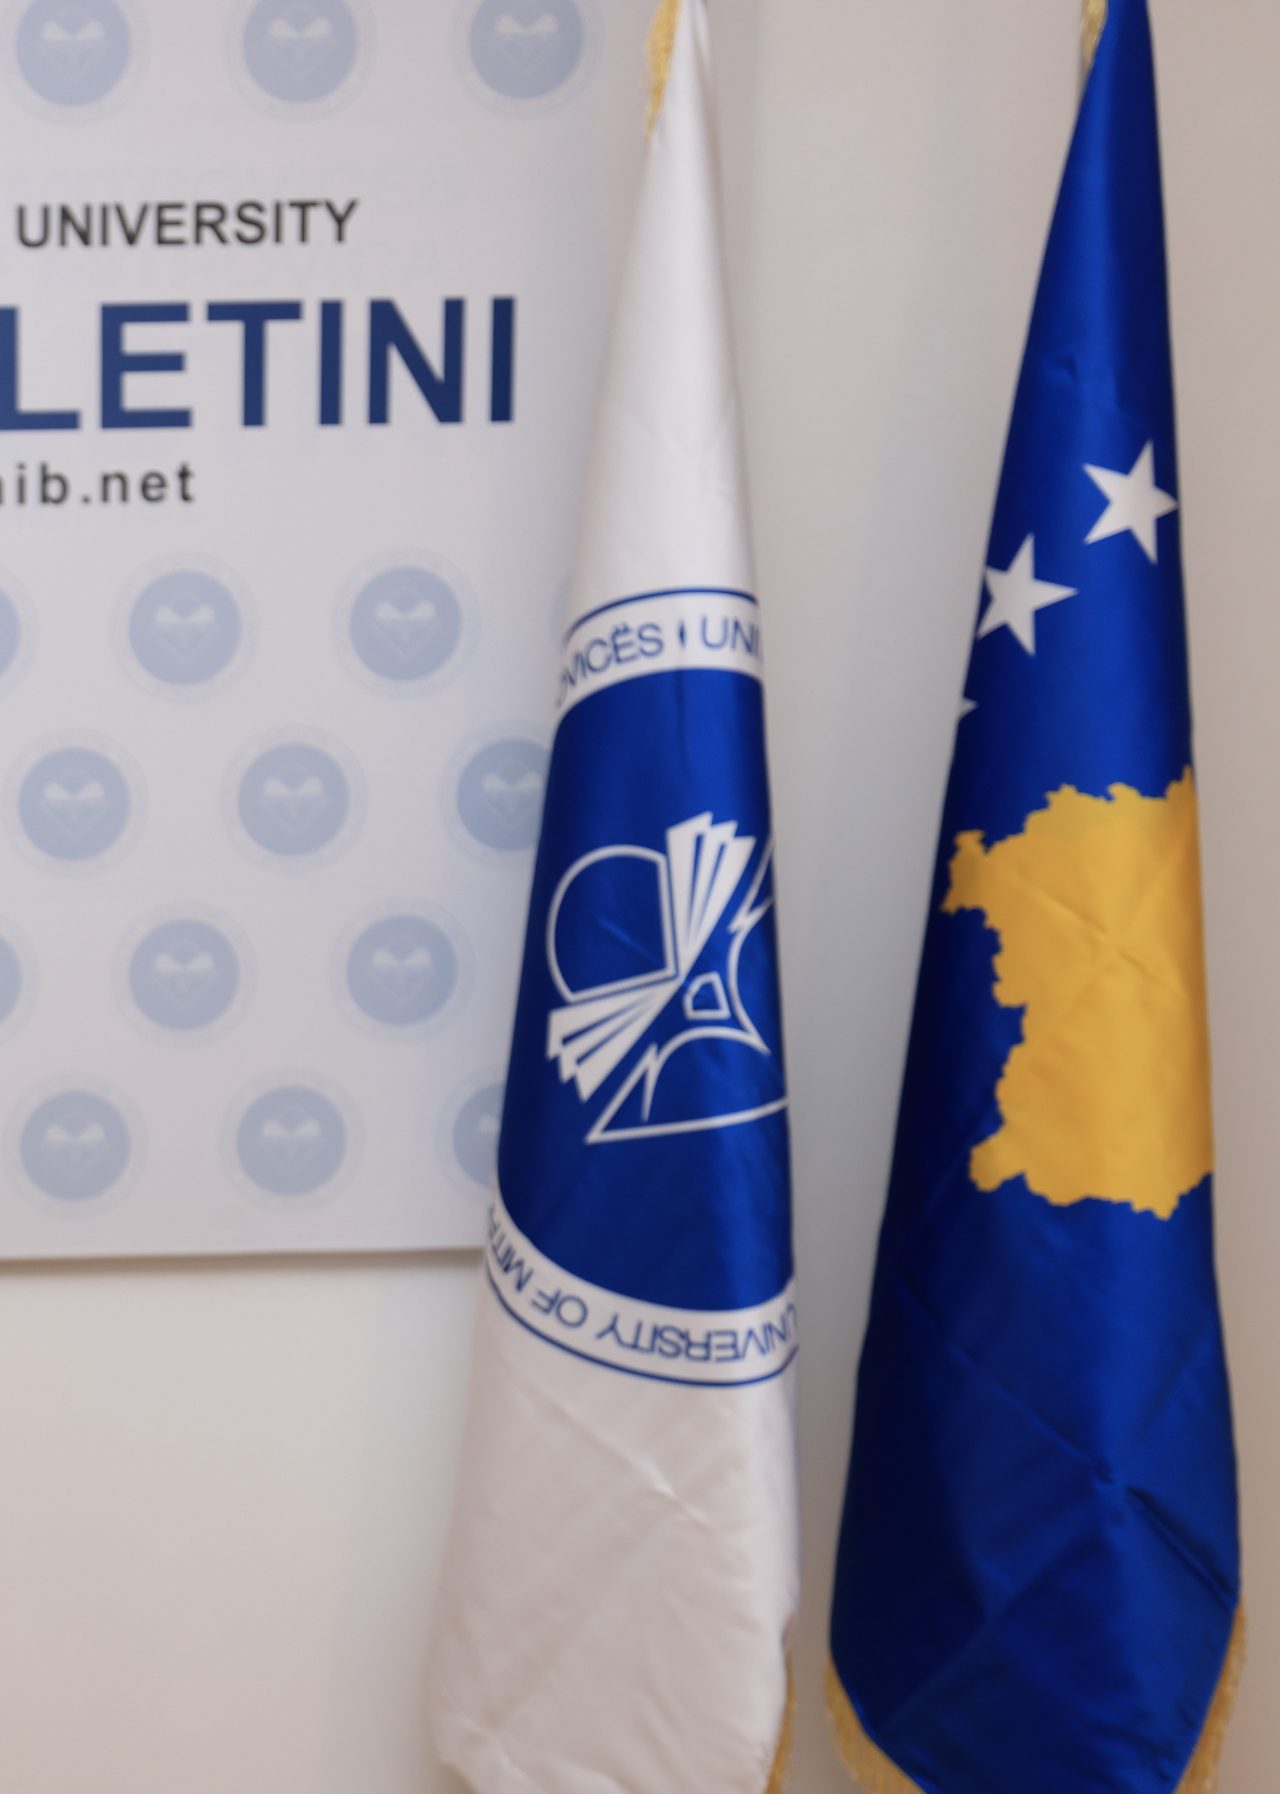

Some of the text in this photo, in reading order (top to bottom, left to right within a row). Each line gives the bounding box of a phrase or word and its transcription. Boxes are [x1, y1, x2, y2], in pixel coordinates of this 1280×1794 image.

[15, 198, 360, 249] UNIVERSITY
[700, 613, 762, 658] UNI
[531, 1288, 589, 1330] OF
